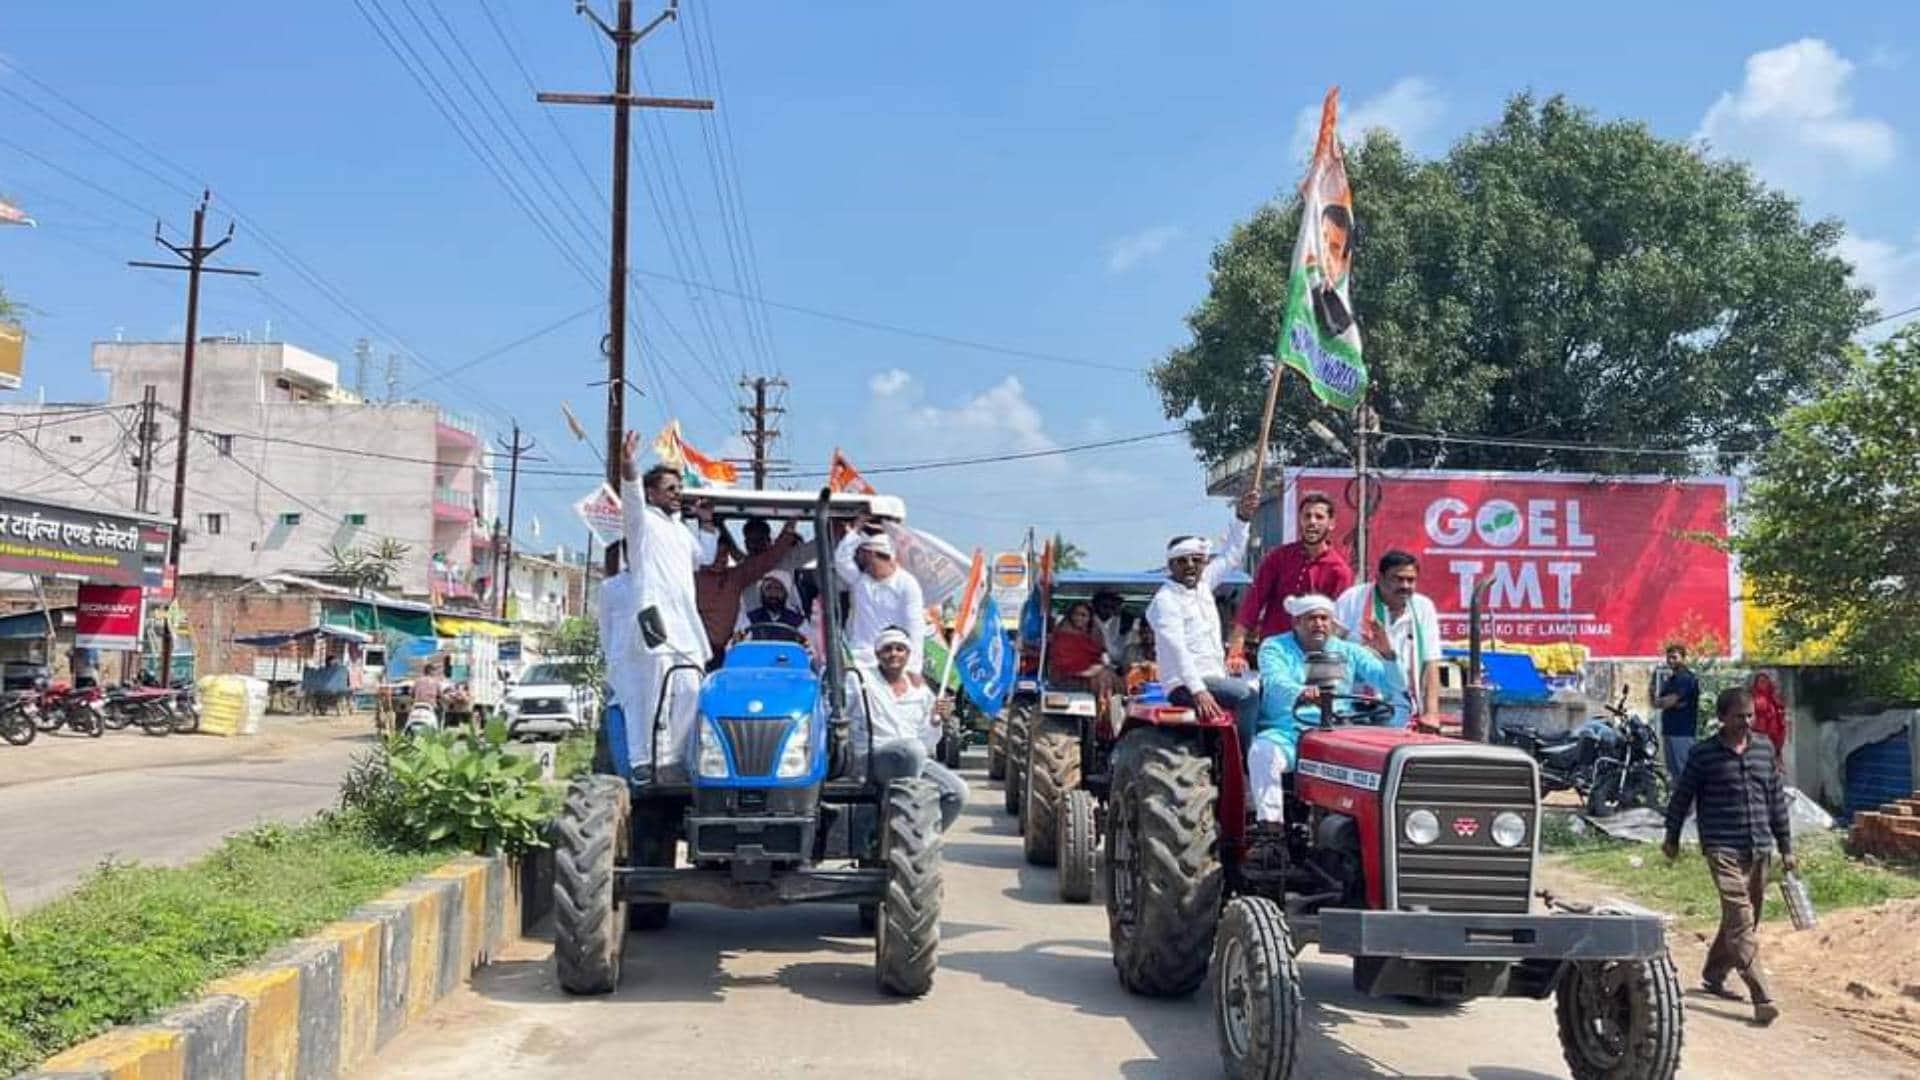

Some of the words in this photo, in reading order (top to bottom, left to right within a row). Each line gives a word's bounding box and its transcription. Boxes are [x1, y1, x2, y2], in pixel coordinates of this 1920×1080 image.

[12, 512, 60, 541] टाईल्स
[63, 523, 92, 545] एण्ड
[95, 521, 138, 551] सेनेटरी
[1425, 498, 1594, 547] GOEL
[1449, 561, 1581, 609] TMT
[1516, 623, 1534, 635] DE
